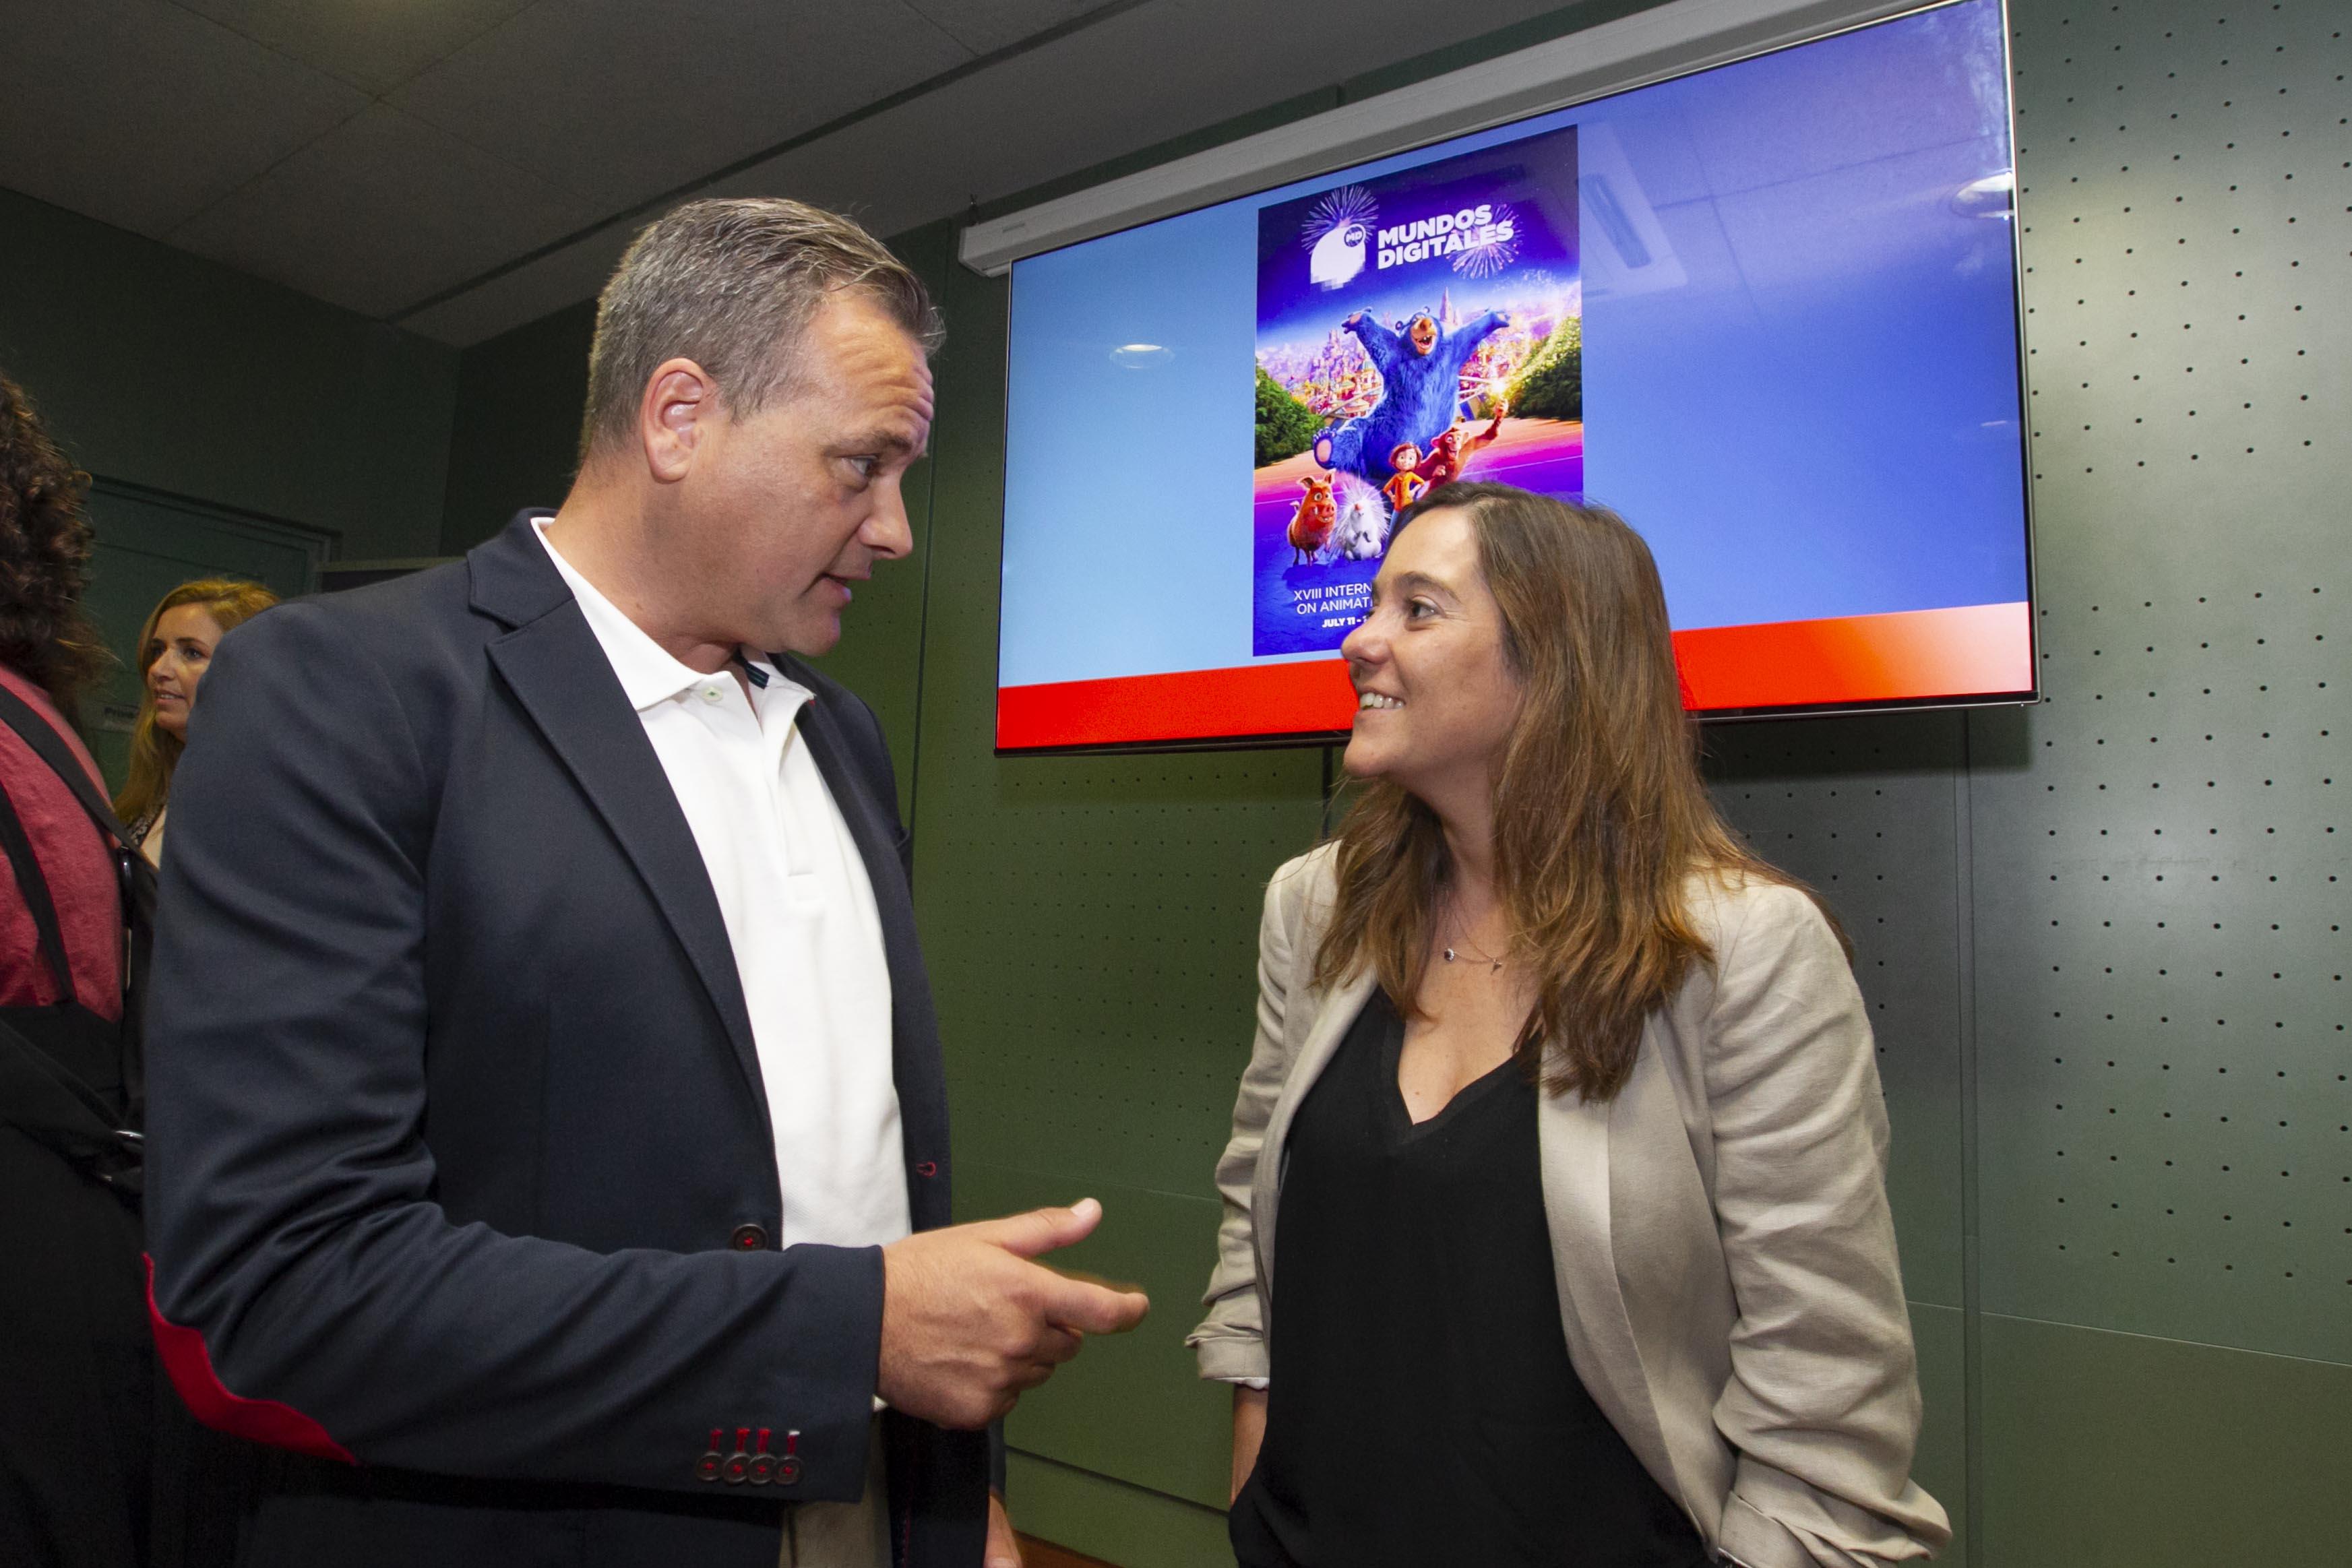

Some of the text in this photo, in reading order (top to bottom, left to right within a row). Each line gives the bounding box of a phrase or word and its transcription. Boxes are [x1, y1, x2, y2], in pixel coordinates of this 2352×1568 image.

[1378, 205, 1492, 249] MUNDOS
[1346, 230, 1363, 243] MD
[1378, 220, 1514, 270] DIGITALES
[1294, 588, 1322, 601] XVIII
[1297, 603, 1316, 615] ON
[1322, 618, 1345, 628] JULY
[1347, 617, 1355, 625] 11
